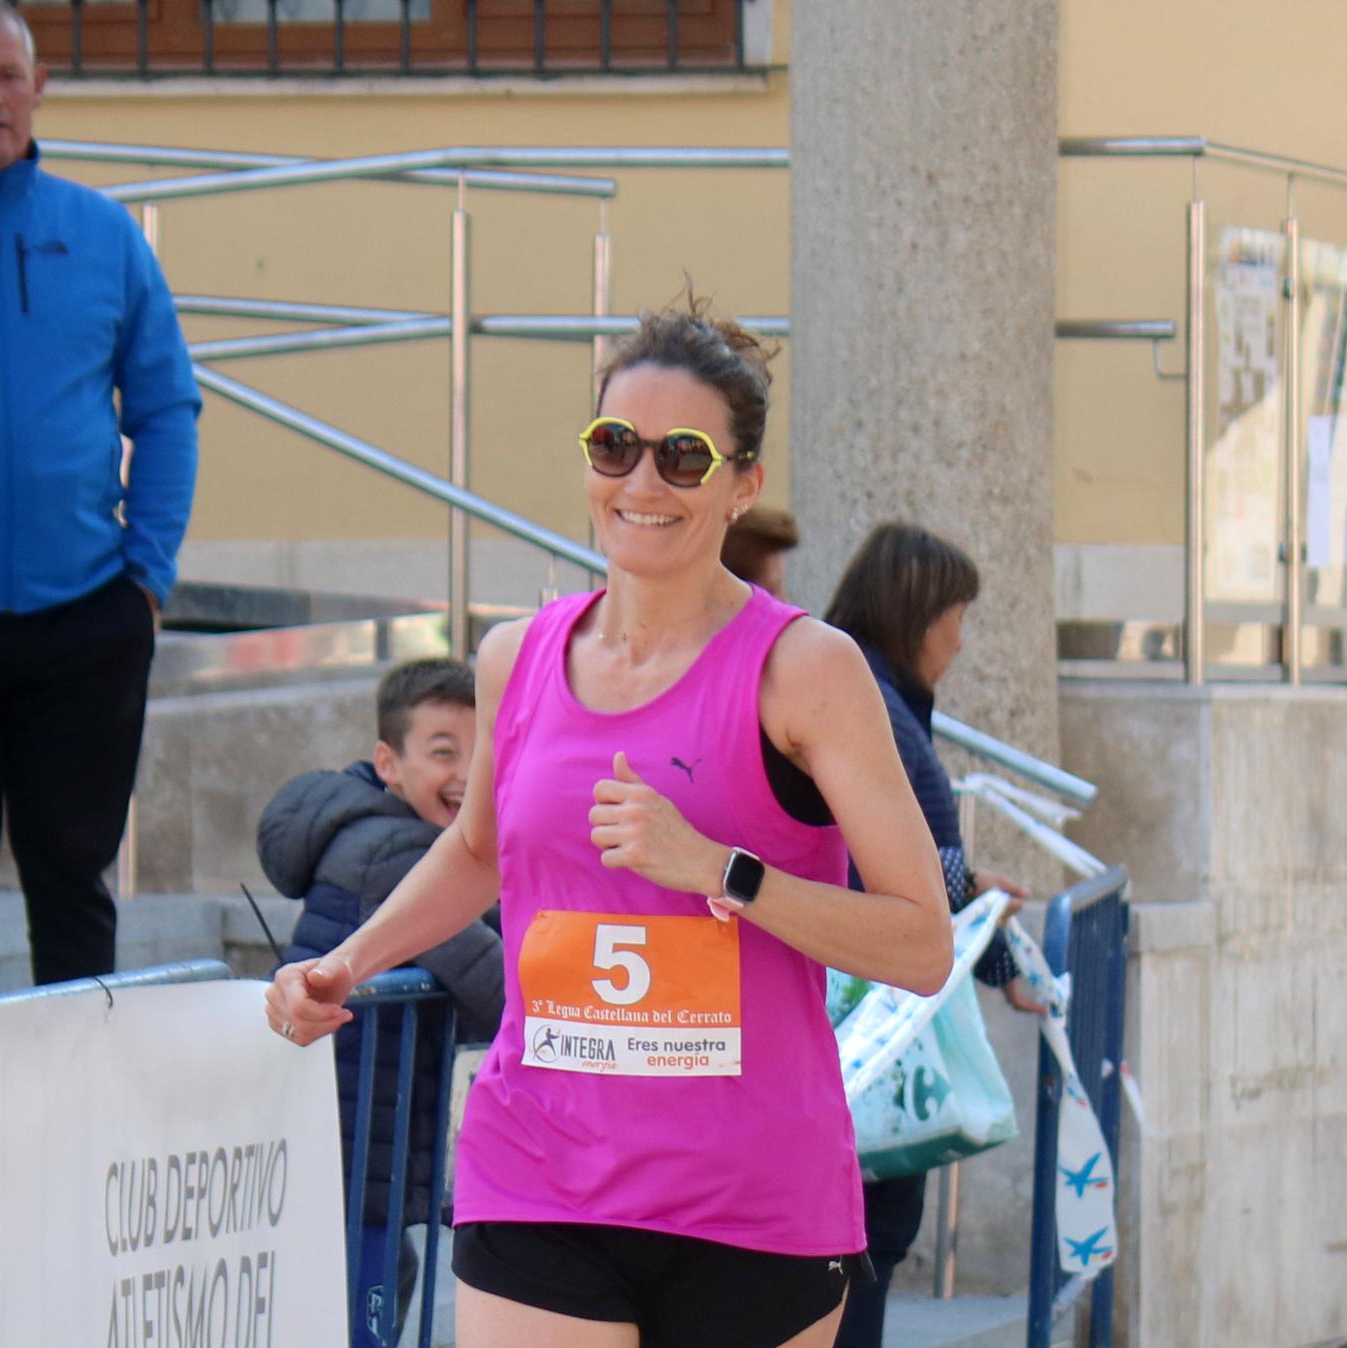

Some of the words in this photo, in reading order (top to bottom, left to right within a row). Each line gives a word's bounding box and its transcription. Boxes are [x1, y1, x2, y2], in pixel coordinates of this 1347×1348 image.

[591, 924, 650, 1005] 5
[546, 1001, 581, 1020] Legua
[584, 1005, 649, 1023] Castellana
[653, 1008, 672, 1024] del
[677, 1009, 732, 1024] Cerrato
[560, 1034, 616, 1061] INTEGRA
[627, 1037, 658, 1052] Eres
[664, 1038, 726, 1053] nuestra
[647, 1052, 710, 1070] energía
[104, 1157, 158, 1256] CLUB
[163, 1138, 287, 1244] DEPORTIVO
